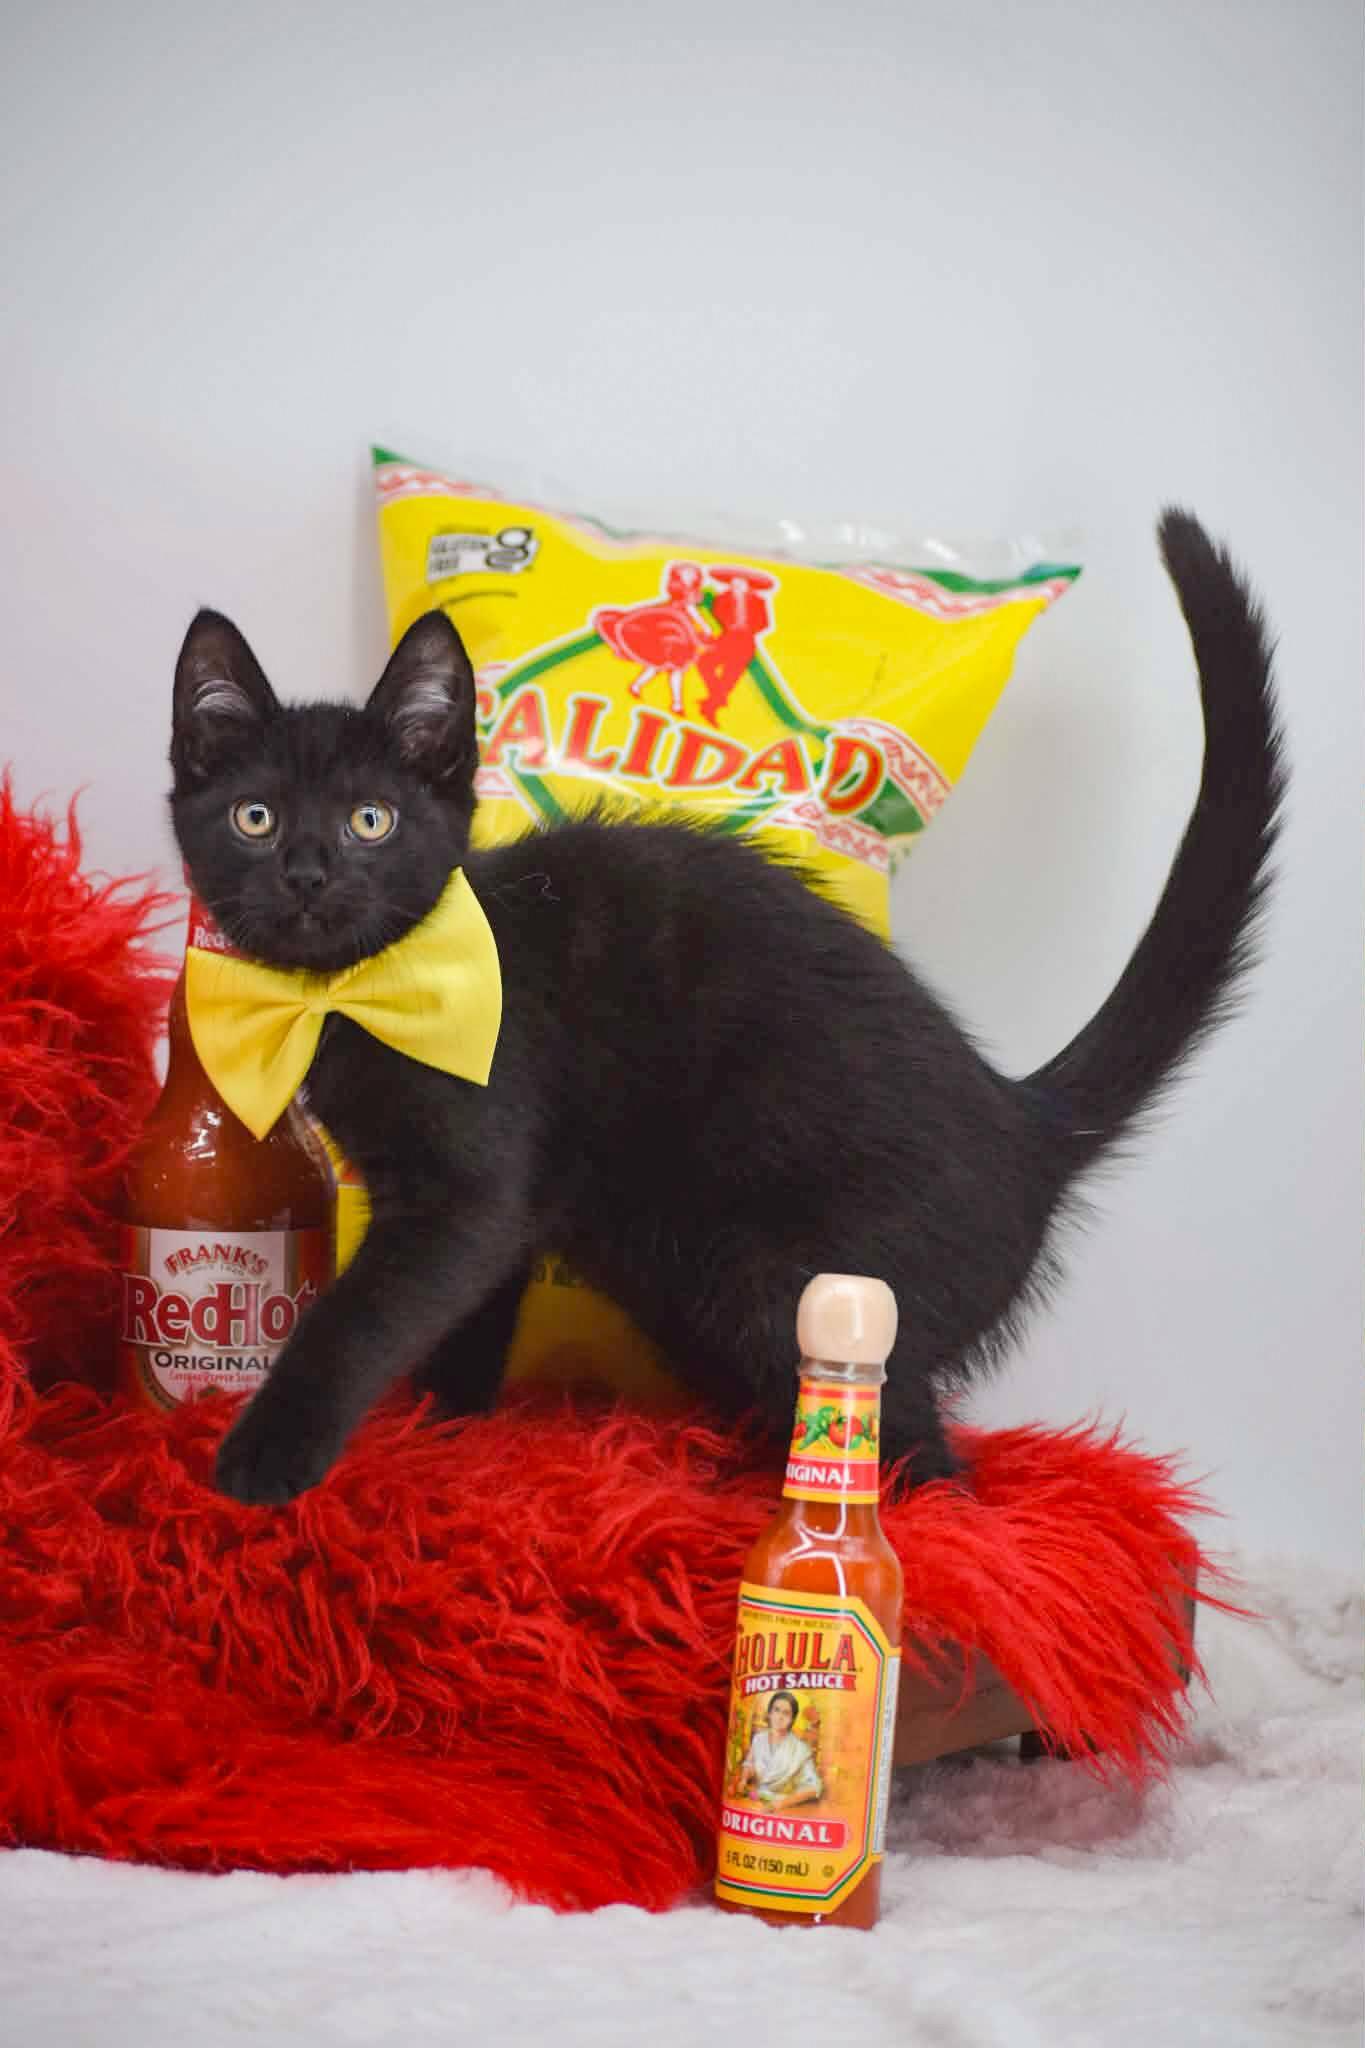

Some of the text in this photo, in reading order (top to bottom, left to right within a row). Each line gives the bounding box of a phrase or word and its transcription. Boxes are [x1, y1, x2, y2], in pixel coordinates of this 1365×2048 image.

[164, 1242, 269, 1277] FRANK'S
[735, 1623, 858, 1678] HOLULA
[745, 1673, 845, 1694] HOT SAUCE
[722, 1810, 833, 1844] ORIGINAL
